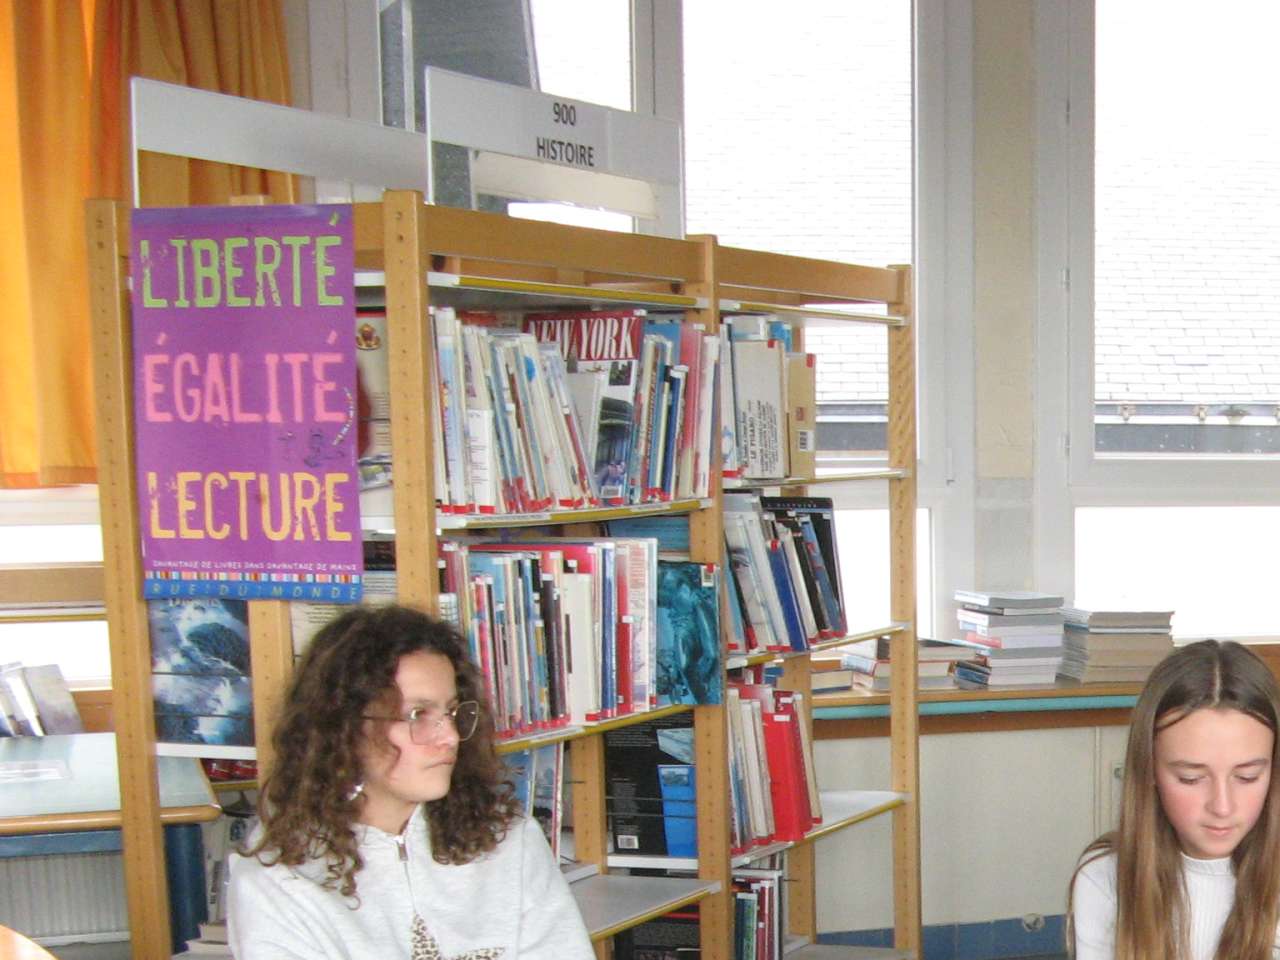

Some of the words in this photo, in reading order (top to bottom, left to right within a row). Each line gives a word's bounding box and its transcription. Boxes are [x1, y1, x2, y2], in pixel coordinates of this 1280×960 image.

[552, 102, 577, 126] 900
[536, 136, 595, 167] HISTOIRE
[139, 212, 345, 309] LIBERTÉ
[579, 316, 638, 362] YORK
[143, 330, 349, 425] ÉGALITÉ
[147, 470, 353, 542] LECTURE
